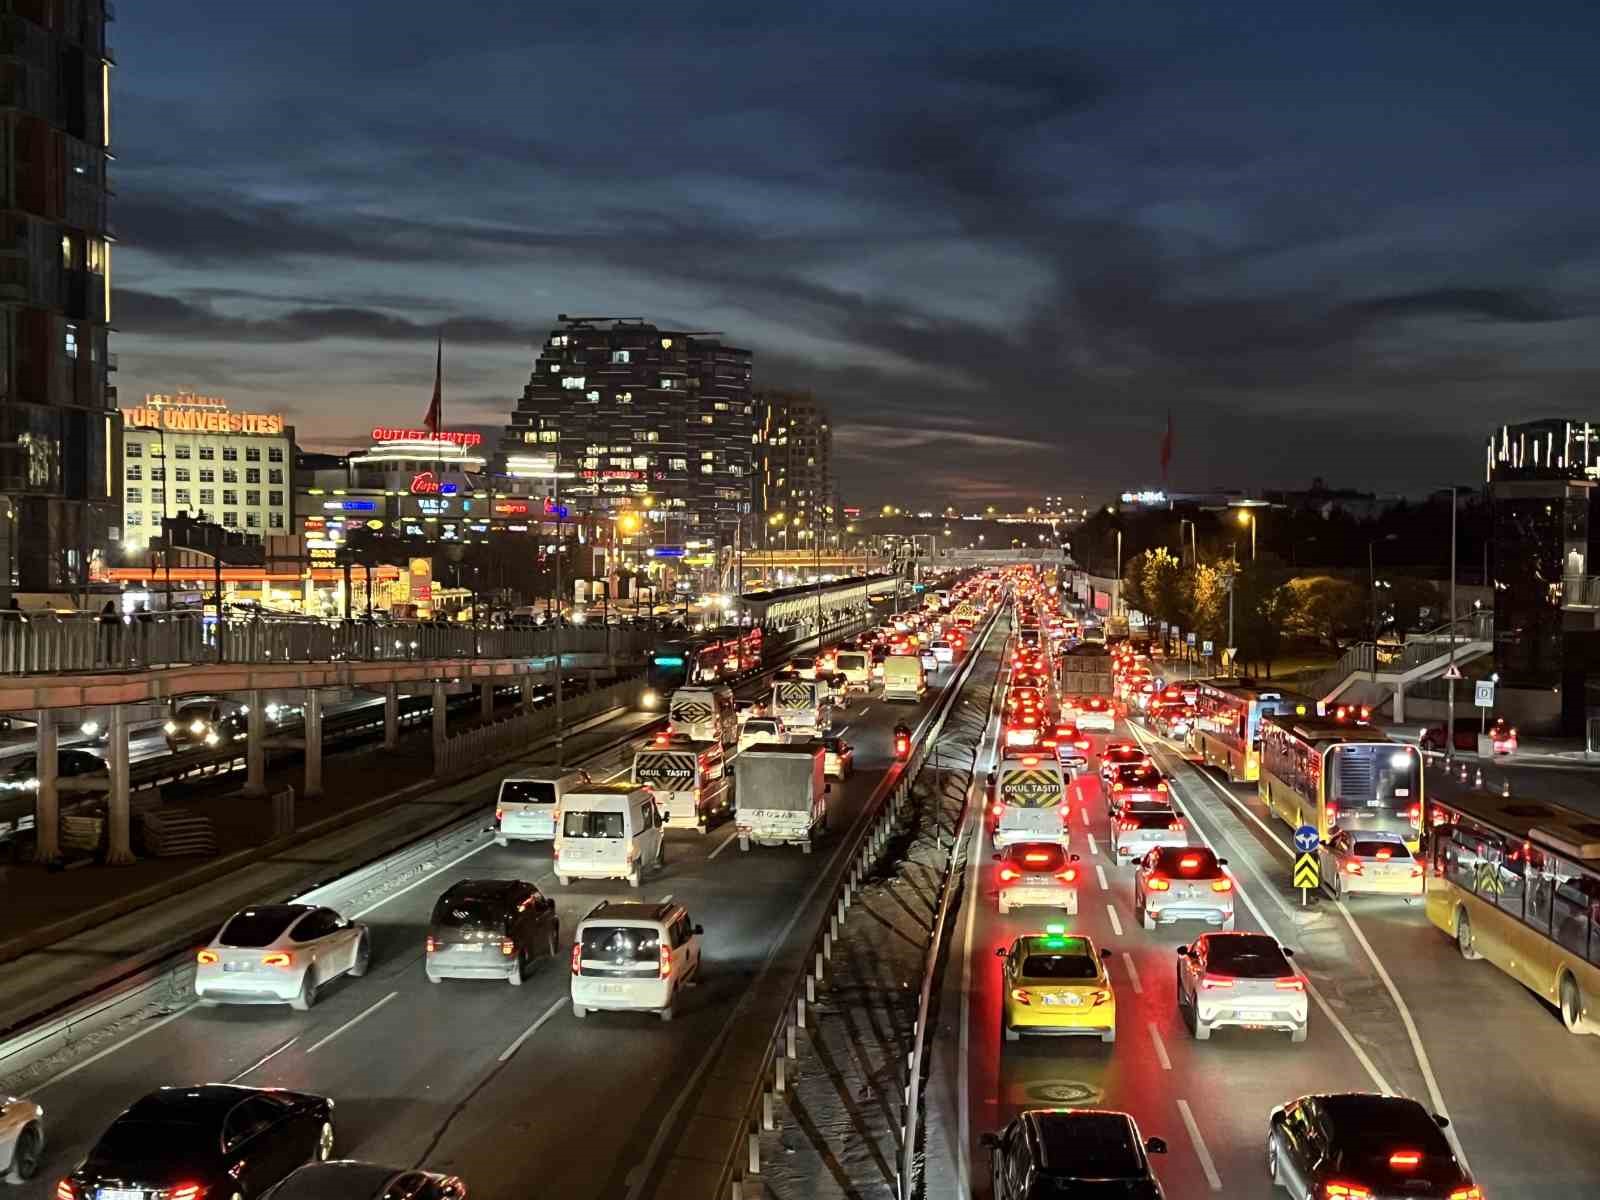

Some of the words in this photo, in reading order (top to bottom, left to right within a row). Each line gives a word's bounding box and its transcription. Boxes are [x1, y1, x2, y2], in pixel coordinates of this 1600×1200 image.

[372, 428, 425, 440] OUTLET
[429, 431, 481, 445] CENTER
[1005, 784, 1030, 793] OKUL
